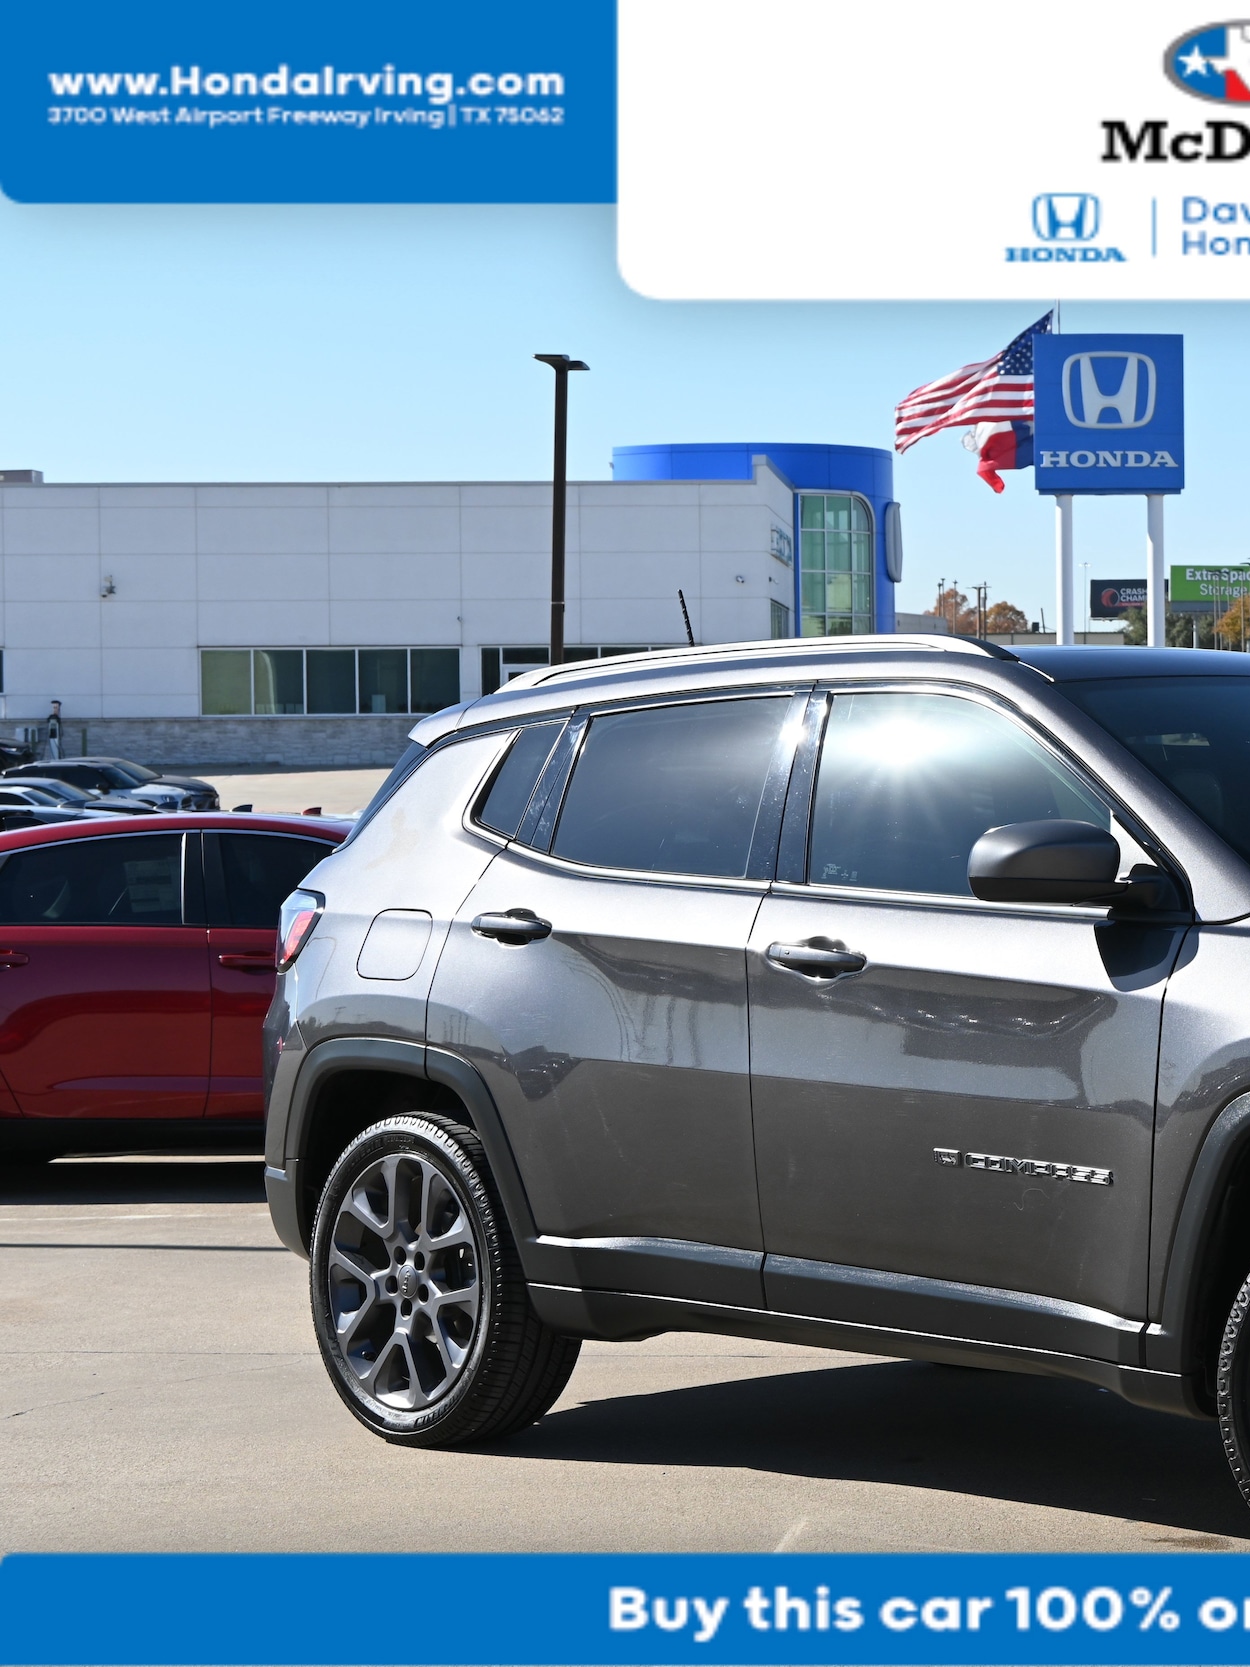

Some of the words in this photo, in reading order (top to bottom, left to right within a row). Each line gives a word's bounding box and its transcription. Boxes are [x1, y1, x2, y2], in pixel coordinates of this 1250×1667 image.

[1040, 450, 1178, 468] HONDA
[1200, 583, 1247, 598] Storage
[965, 1152, 1114, 1186] COMPASS
